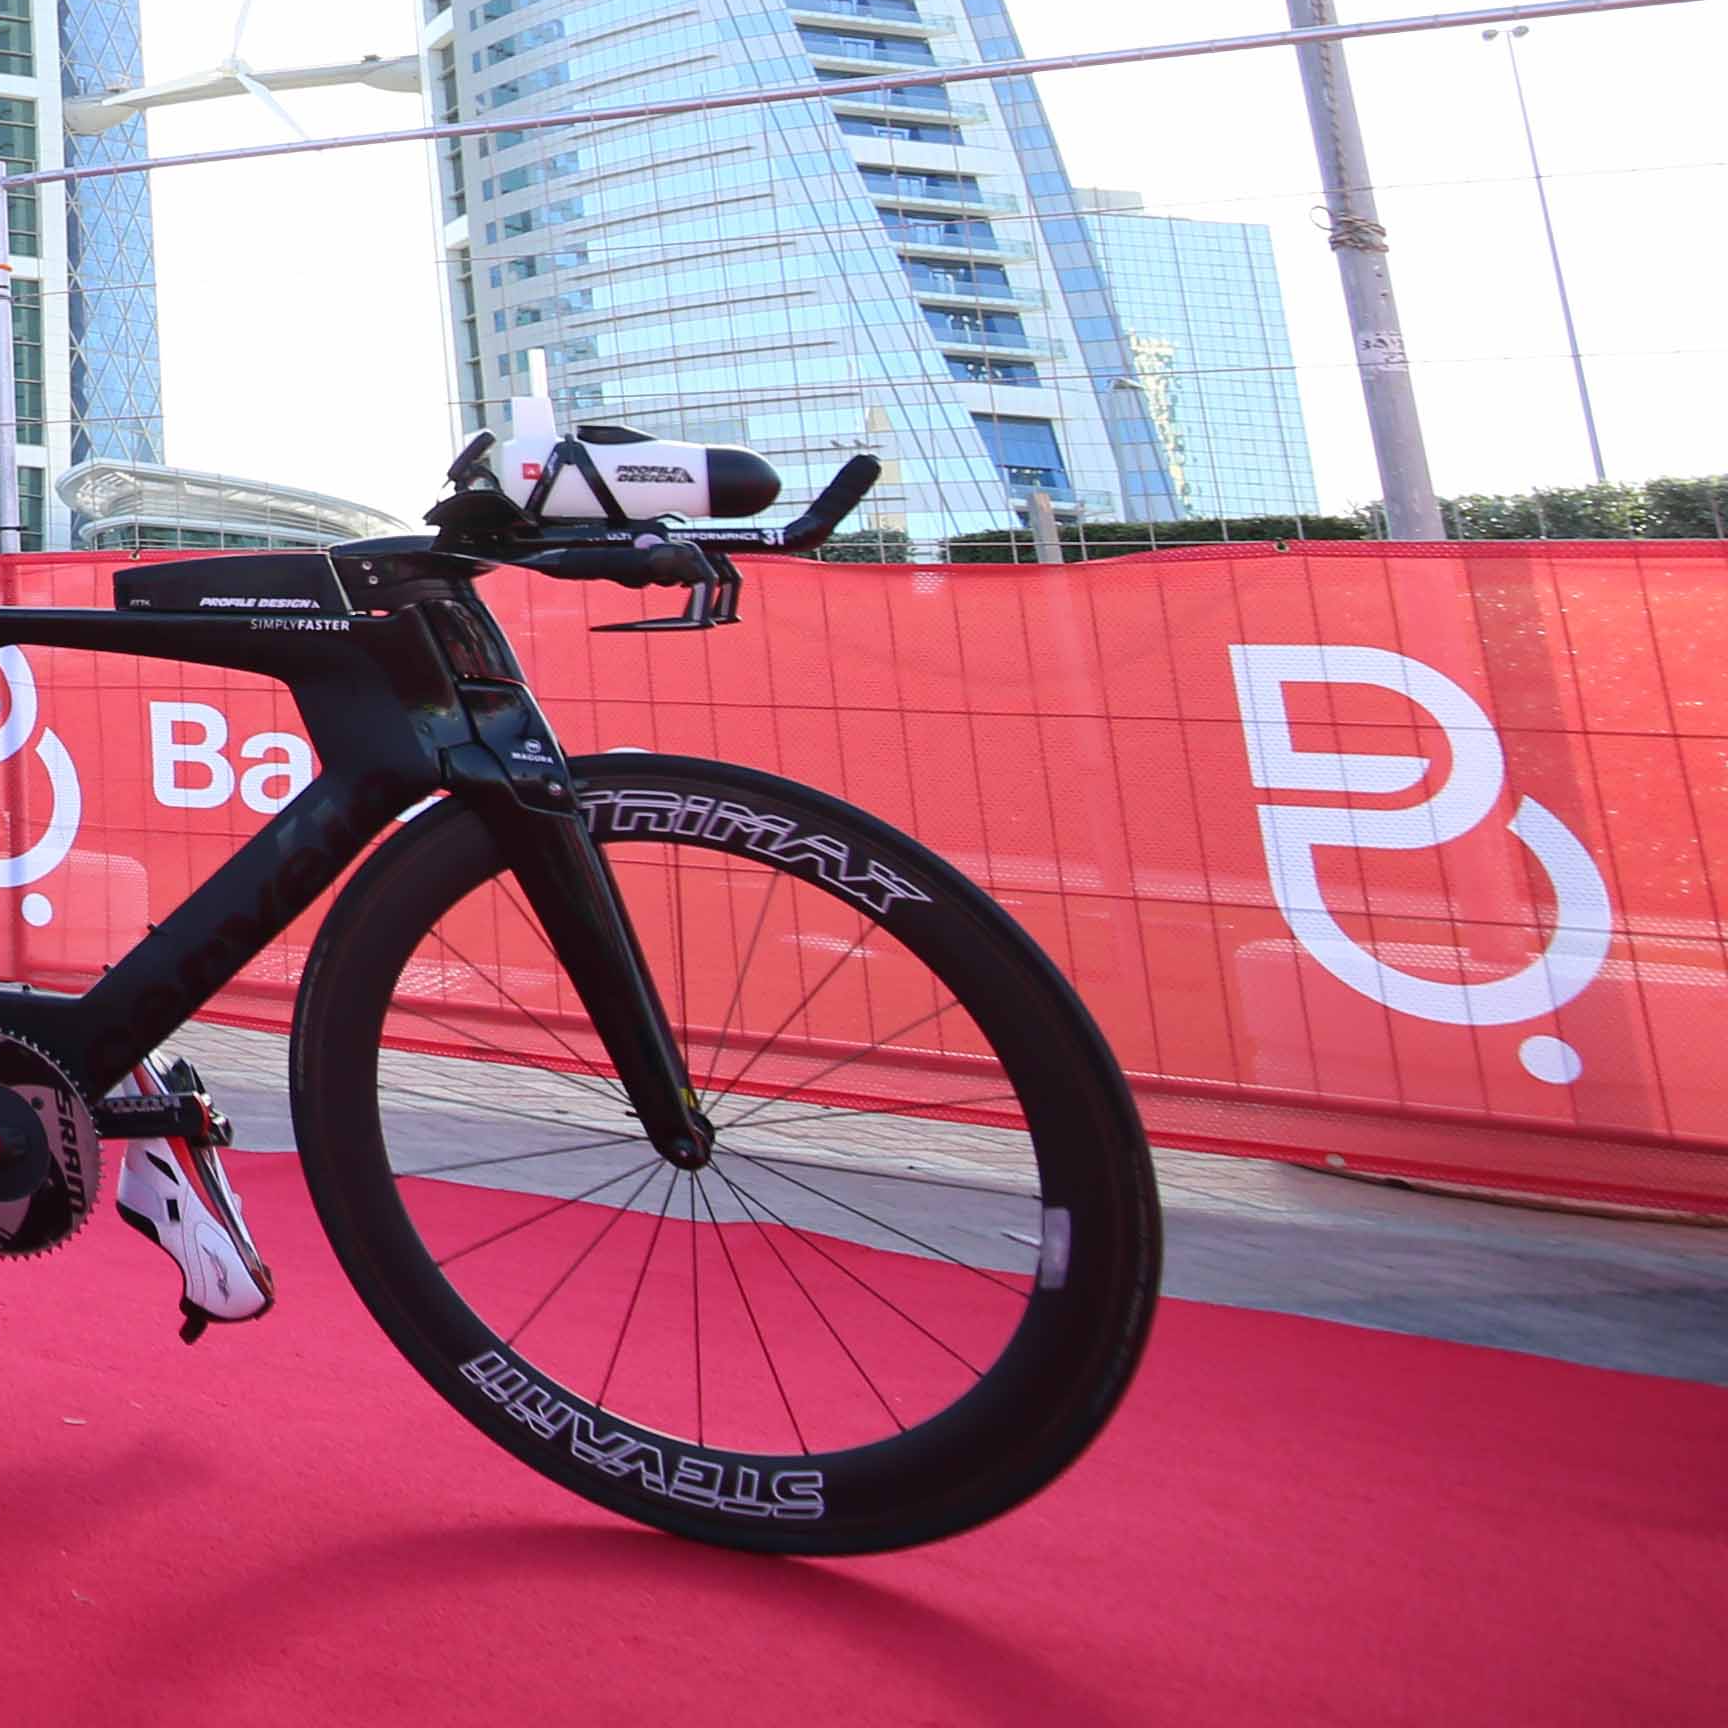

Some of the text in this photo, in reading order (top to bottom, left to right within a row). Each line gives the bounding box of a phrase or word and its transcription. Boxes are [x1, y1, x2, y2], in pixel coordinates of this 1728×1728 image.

[668, 532, 761, 542] PERFORMANCE
[762, 528, 786, 546] 3T
[200, 597, 312, 609] PROFILE DESIGN
[149, 700, 314, 815] Ba
[53, 1086, 88, 1216] SRAM
